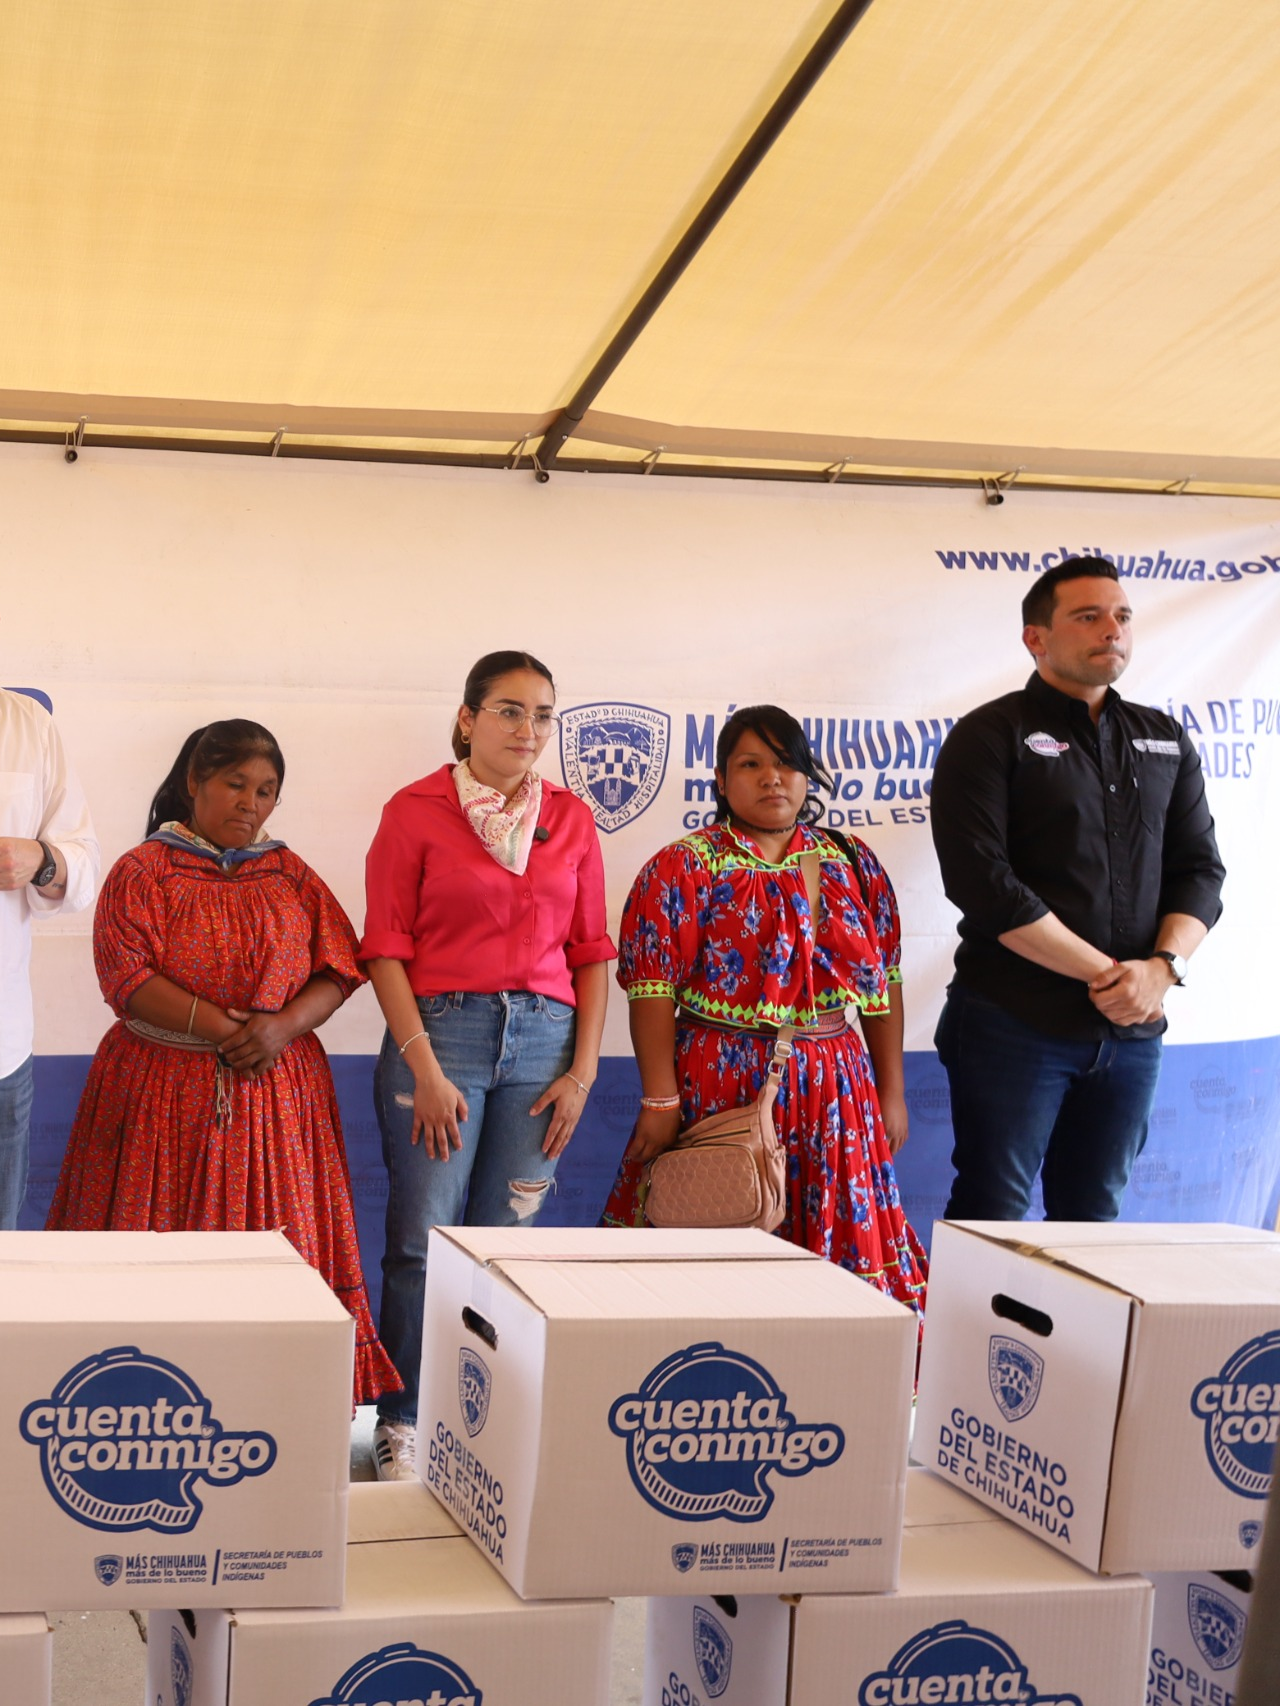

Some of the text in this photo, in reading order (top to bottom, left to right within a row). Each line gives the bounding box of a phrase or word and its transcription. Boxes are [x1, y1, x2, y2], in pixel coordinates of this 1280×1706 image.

[1207, 699, 1244, 734] DE
[829, 772, 863, 801] lo
[828, 809, 882, 828] DEL
[593, 1093, 640, 1105] cuent
[26, 1398, 204, 1438] cuenta
[615, 1391, 779, 1431] cuenta
[58, 1438, 270, 1479] conmigo
[643, 1430, 839, 1470] conmigo
[951, 1407, 1067, 1486] GOBIERNO
[436, 1421, 503, 1506] GOBIERNO
[939, 1425, 1075, 1519] DEL ESTADO
[429, 1439, 451, 1480] DEL
[454, 1467, 507, 1539] ESTADO
[938, 1449, 1071, 1544] DE CHIHUAHUA
[427, 1463, 504, 1565] DE CHIHUAHUA
[223, 1550, 272, 1560] SECRETARÍA
[286, 1550, 323, 1559] PUEBLOS
[700, 1541, 775, 1557] MÁS CHIHUAHUA
[791, 1538, 835, 1547] SECRETARÍA
[848, 1537, 883, 1546] PUEBLOS
[796, 1549, 849, 1557] COMUNIDADES
[126, 1554, 207, 1570] MÁS CHIHUAHUA
[126, 1569, 146, 1577] más
[176, 1568, 207, 1577] bueno
[230, 1562, 287, 1570] COMUNIDADES
[700, 1556, 719, 1564] más
[746, 1555, 775, 1564] bueno
[789, 1559, 828, 1568] INDÍGENAS
[222, 1572, 265, 1581] INDÍGENAS
[865, 1666, 1022, 1706] cuenta
